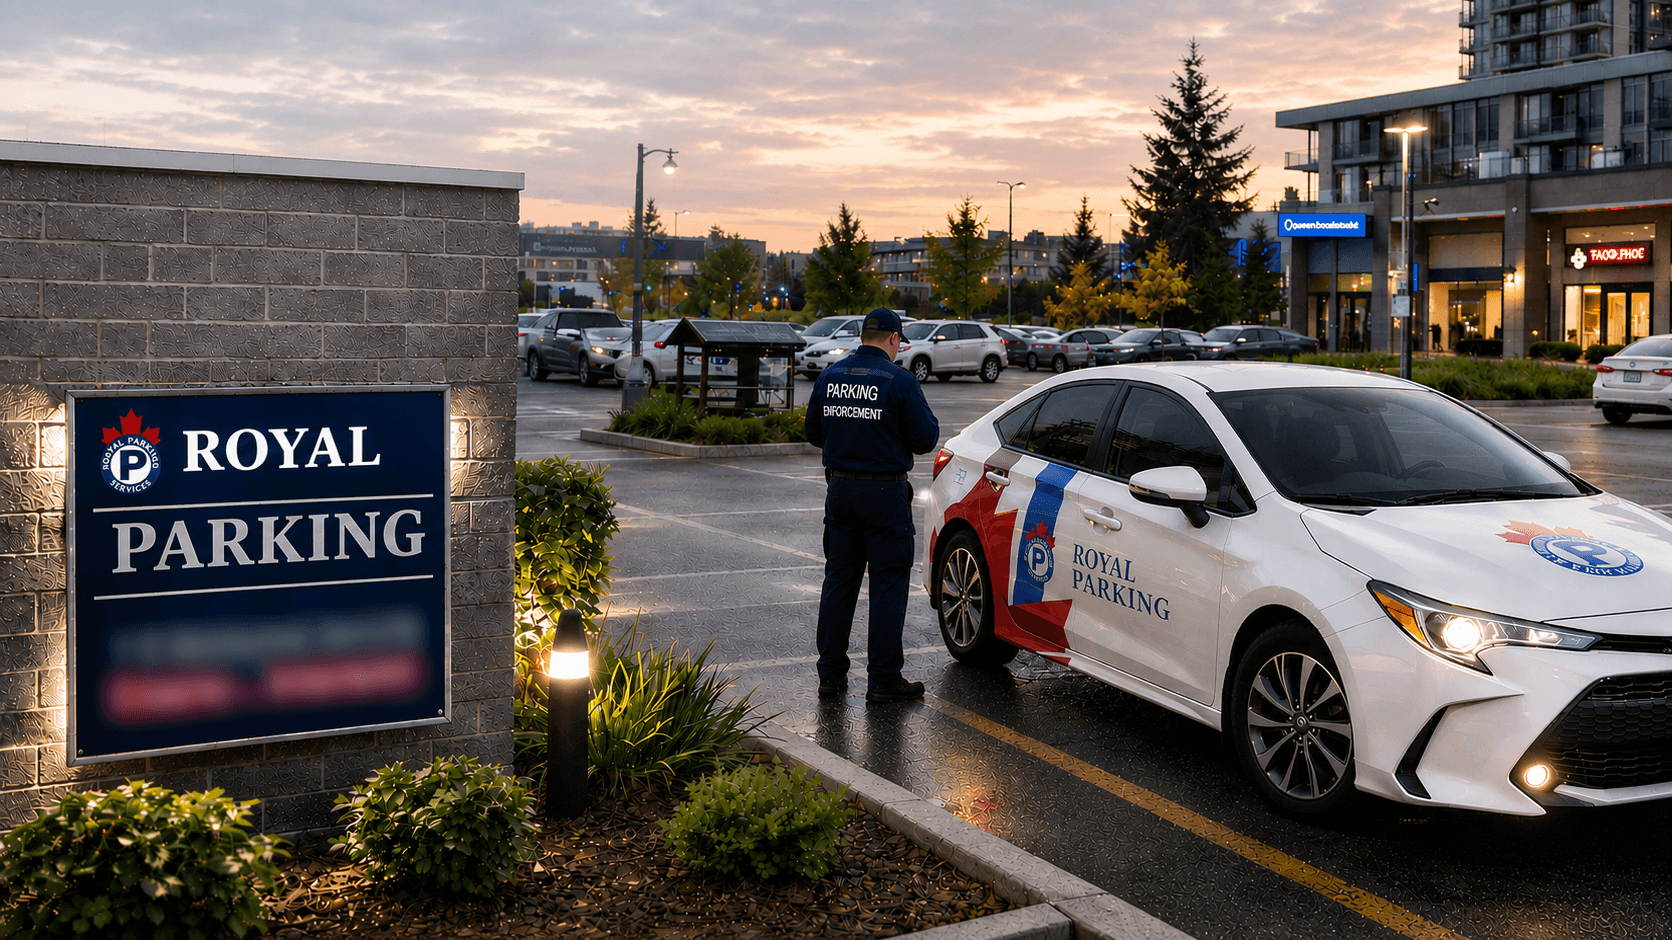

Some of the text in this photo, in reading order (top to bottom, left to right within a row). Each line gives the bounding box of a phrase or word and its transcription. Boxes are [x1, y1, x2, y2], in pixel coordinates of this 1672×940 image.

[826, 383, 879, 401] PARKING
[119, 449, 148, 481] P
[182, 425, 381, 472] ROYAL
[109, 479, 152, 494] SERVICES
[111, 509, 426, 574] PARKING
[1031, 546, 1046, 572] P
[1072, 543, 1136, 584] ROYAL
[1072, 568, 1171, 621] PARKING
